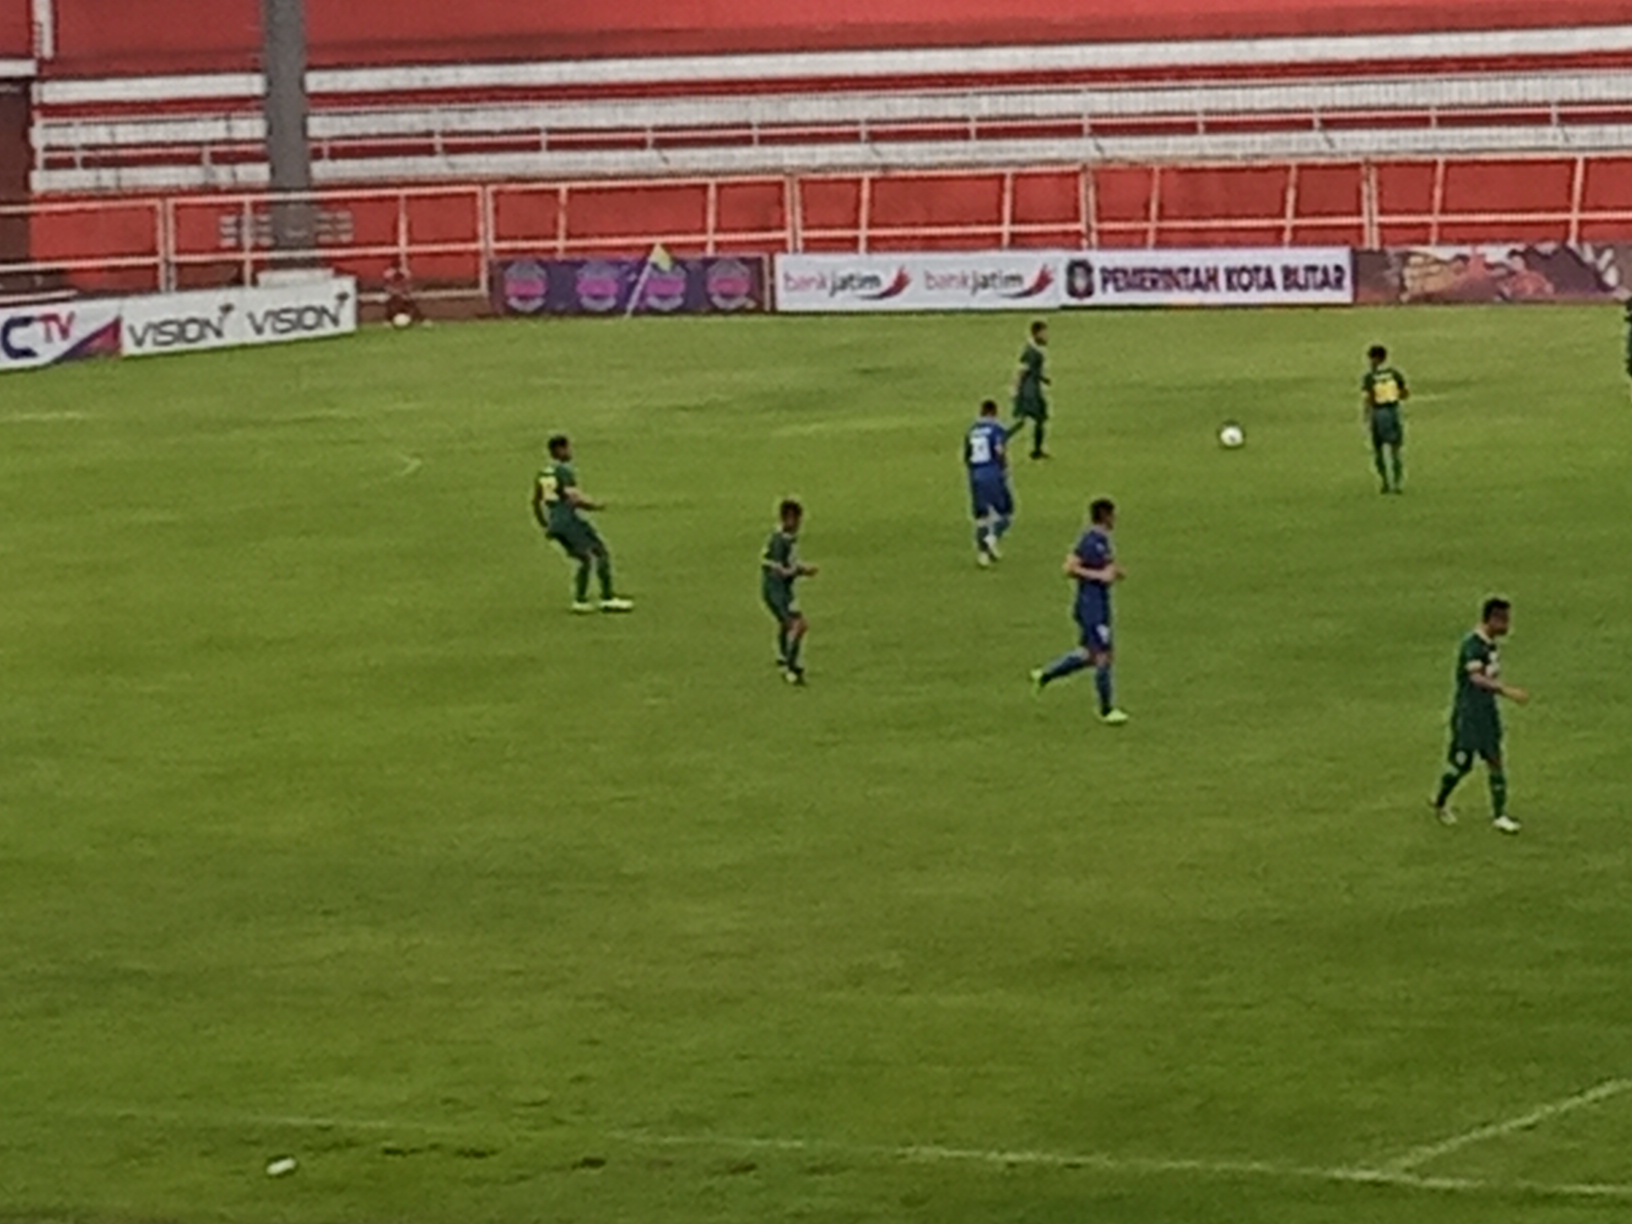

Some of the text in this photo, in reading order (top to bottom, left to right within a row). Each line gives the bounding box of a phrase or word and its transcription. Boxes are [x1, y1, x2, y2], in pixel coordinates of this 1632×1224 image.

[1100, 266, 1220, 293] PEMERINTAH
[1224, 265, 1277, 292] KOTA
[127, 313, 226, 349] VISION
[246, 301, 341, 336] VISION
